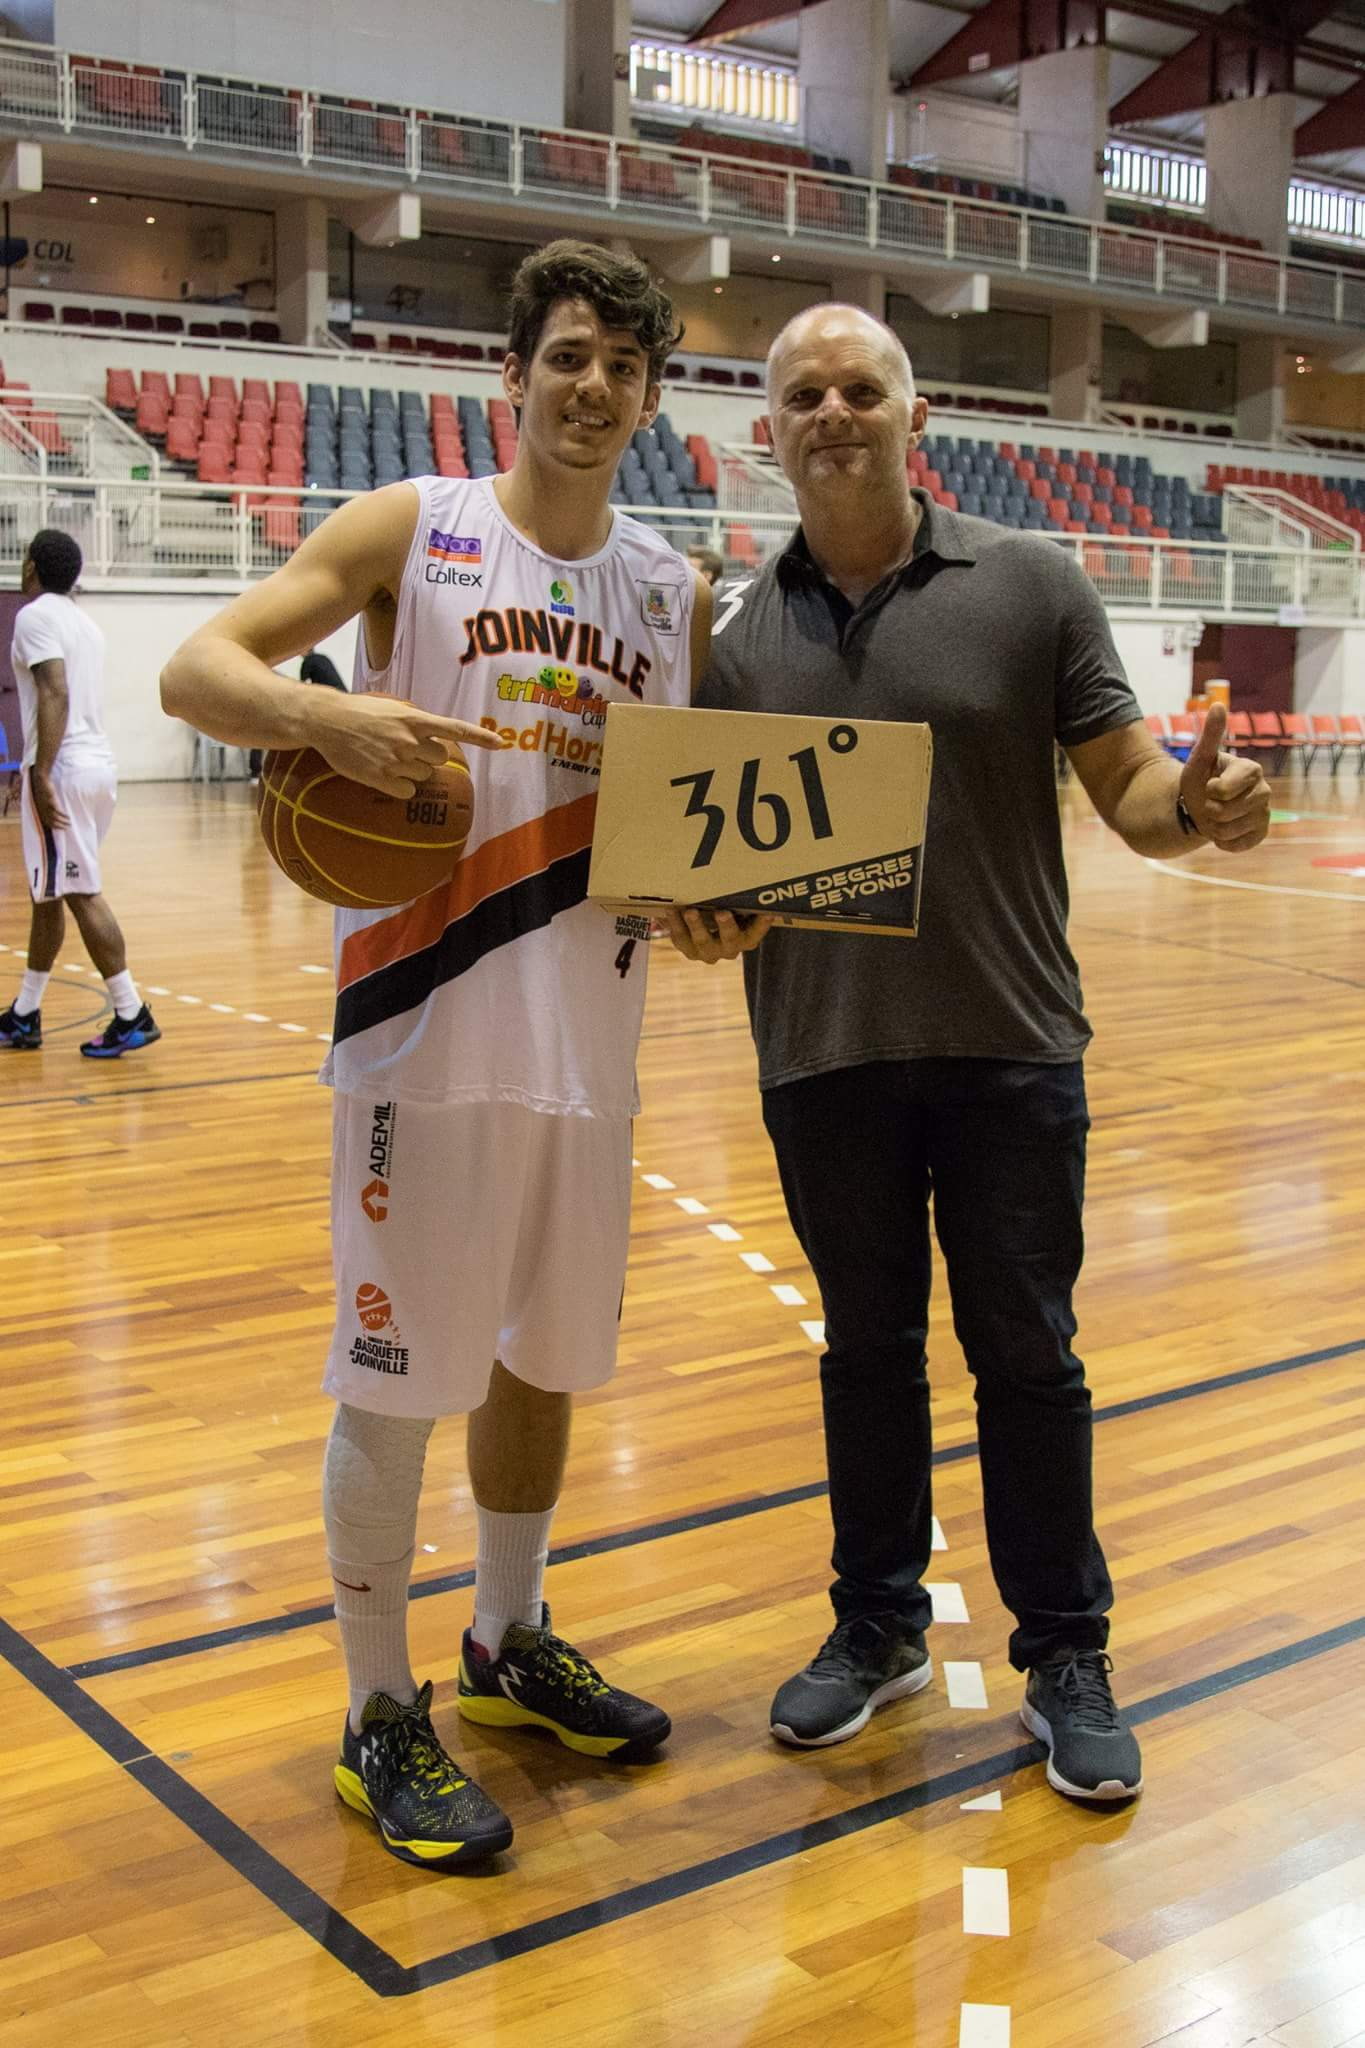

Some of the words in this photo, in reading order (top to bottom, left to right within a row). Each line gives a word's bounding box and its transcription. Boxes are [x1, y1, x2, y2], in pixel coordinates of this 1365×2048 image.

[34, 239, 75, 263] CDL
[425, 563, 483, 588] Coltex
[459, 607, 652, 700] JOINVILLE
[405, 801, 448, 826] FIBA
[758, 881, 809, 905] ONE
[815, 854, 913, 892] DEGREE
[810, 871, 912, 910] BEYOND
[615, 938, 637, 978] 4
[369, 1101, 391, 1177] ADEMIL
[351, 1352, 408, 1375] JOINVILLE
[354, 1336, 408, 1361] BASQUETE
